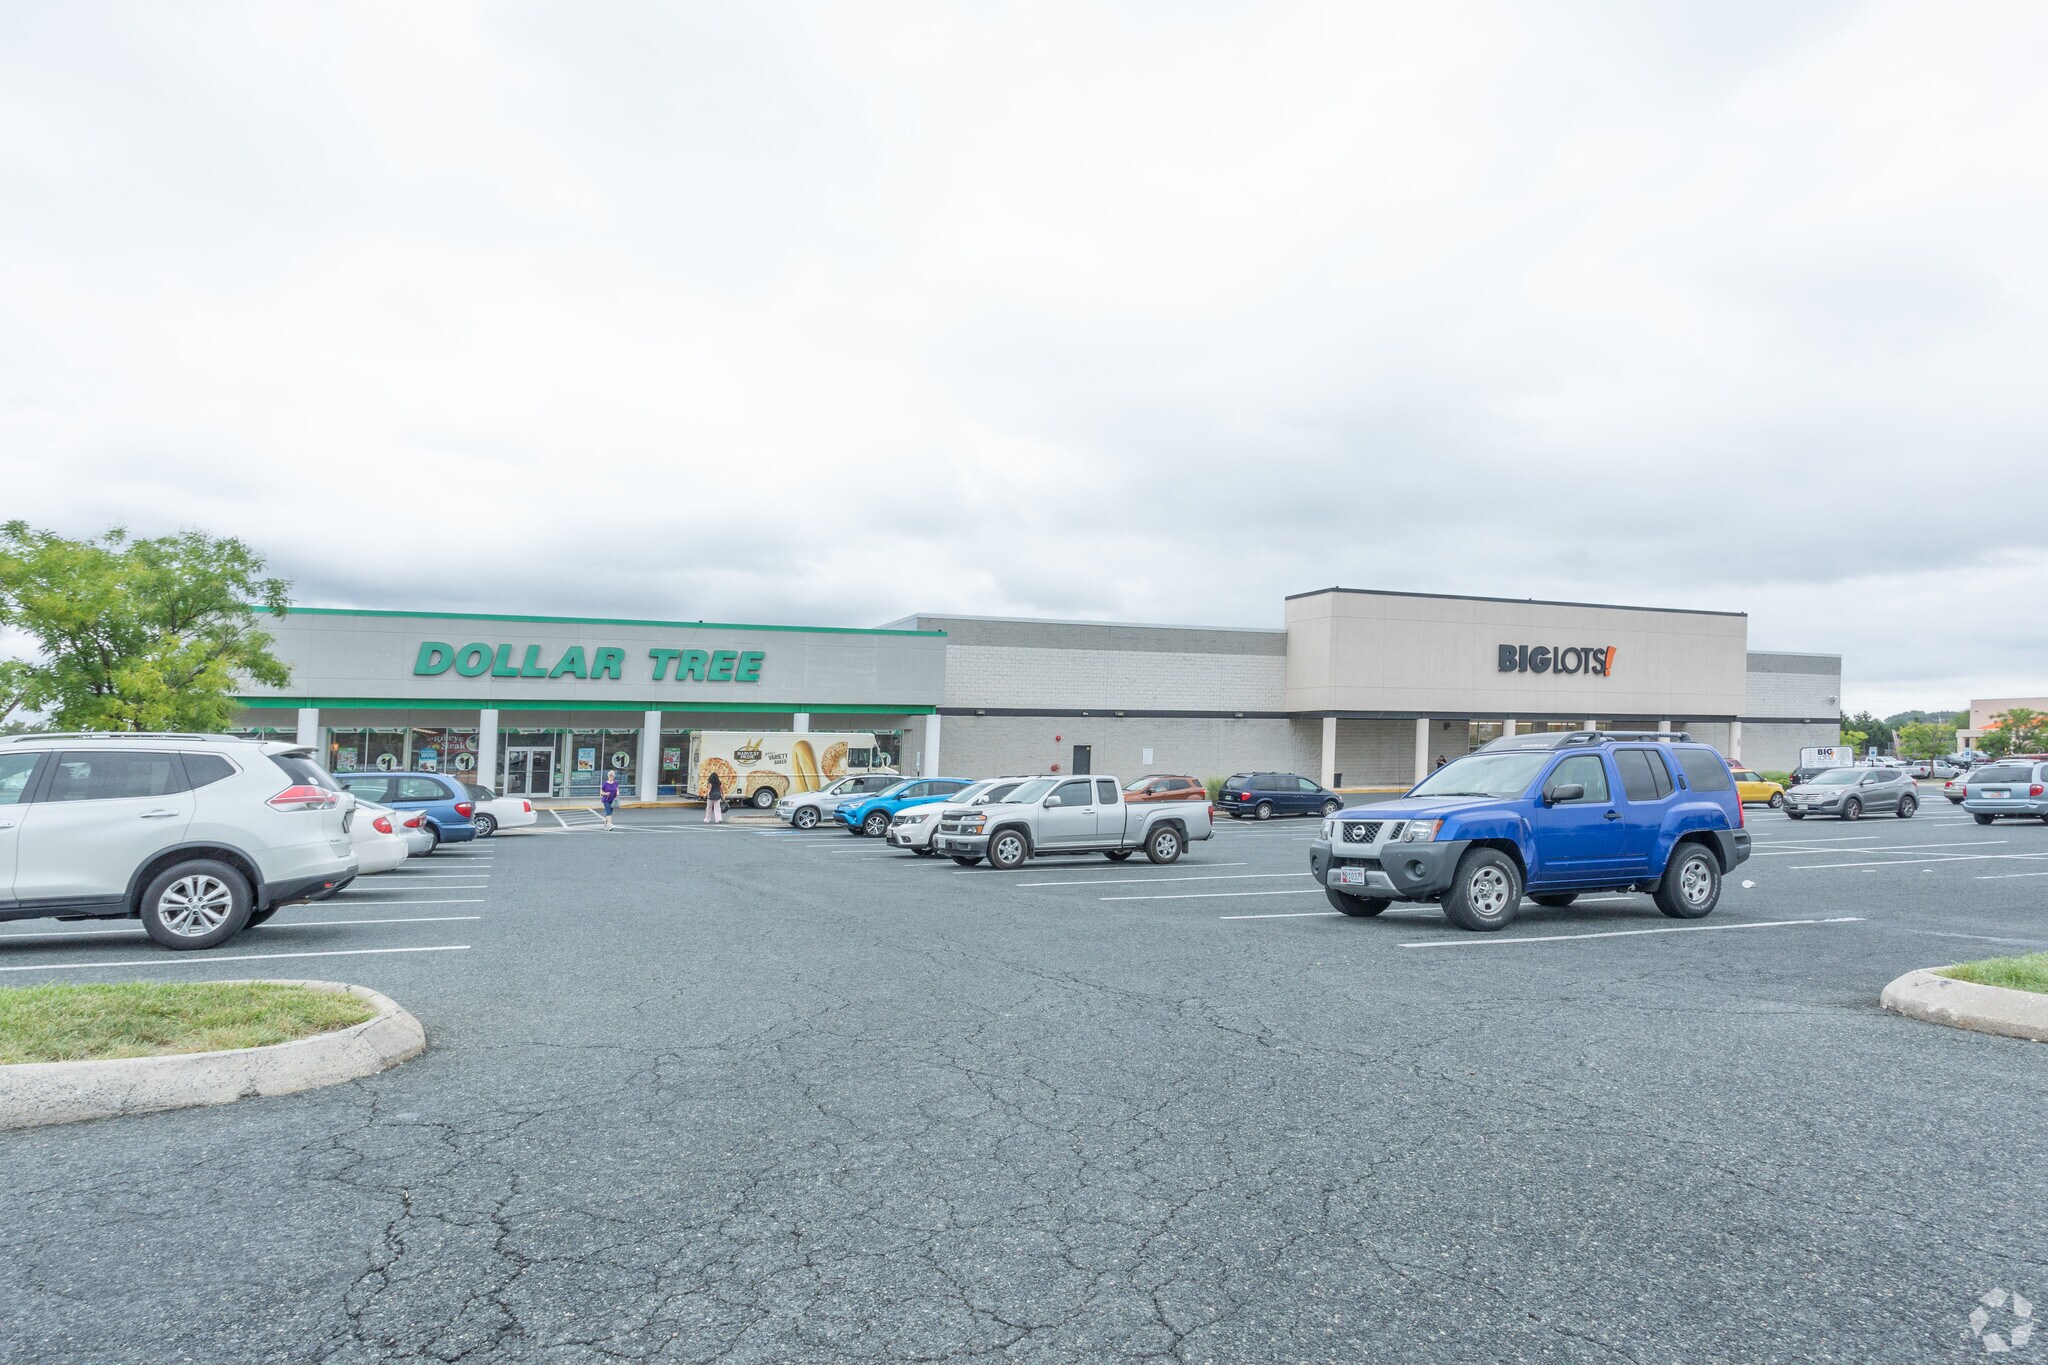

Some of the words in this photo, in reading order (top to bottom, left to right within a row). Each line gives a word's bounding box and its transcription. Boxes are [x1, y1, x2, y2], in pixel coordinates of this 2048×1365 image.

[413, 641, 626, 679] DOLLAR
[648, 648, 766, 682] TREE
[441, 742, 466, 750] Seak
[1817, 748, 1833, 756] BIG
[381, 757, 392, 770] $1
[459, 757, 470, 770] $1
[615, 755, 625, 768] $1
